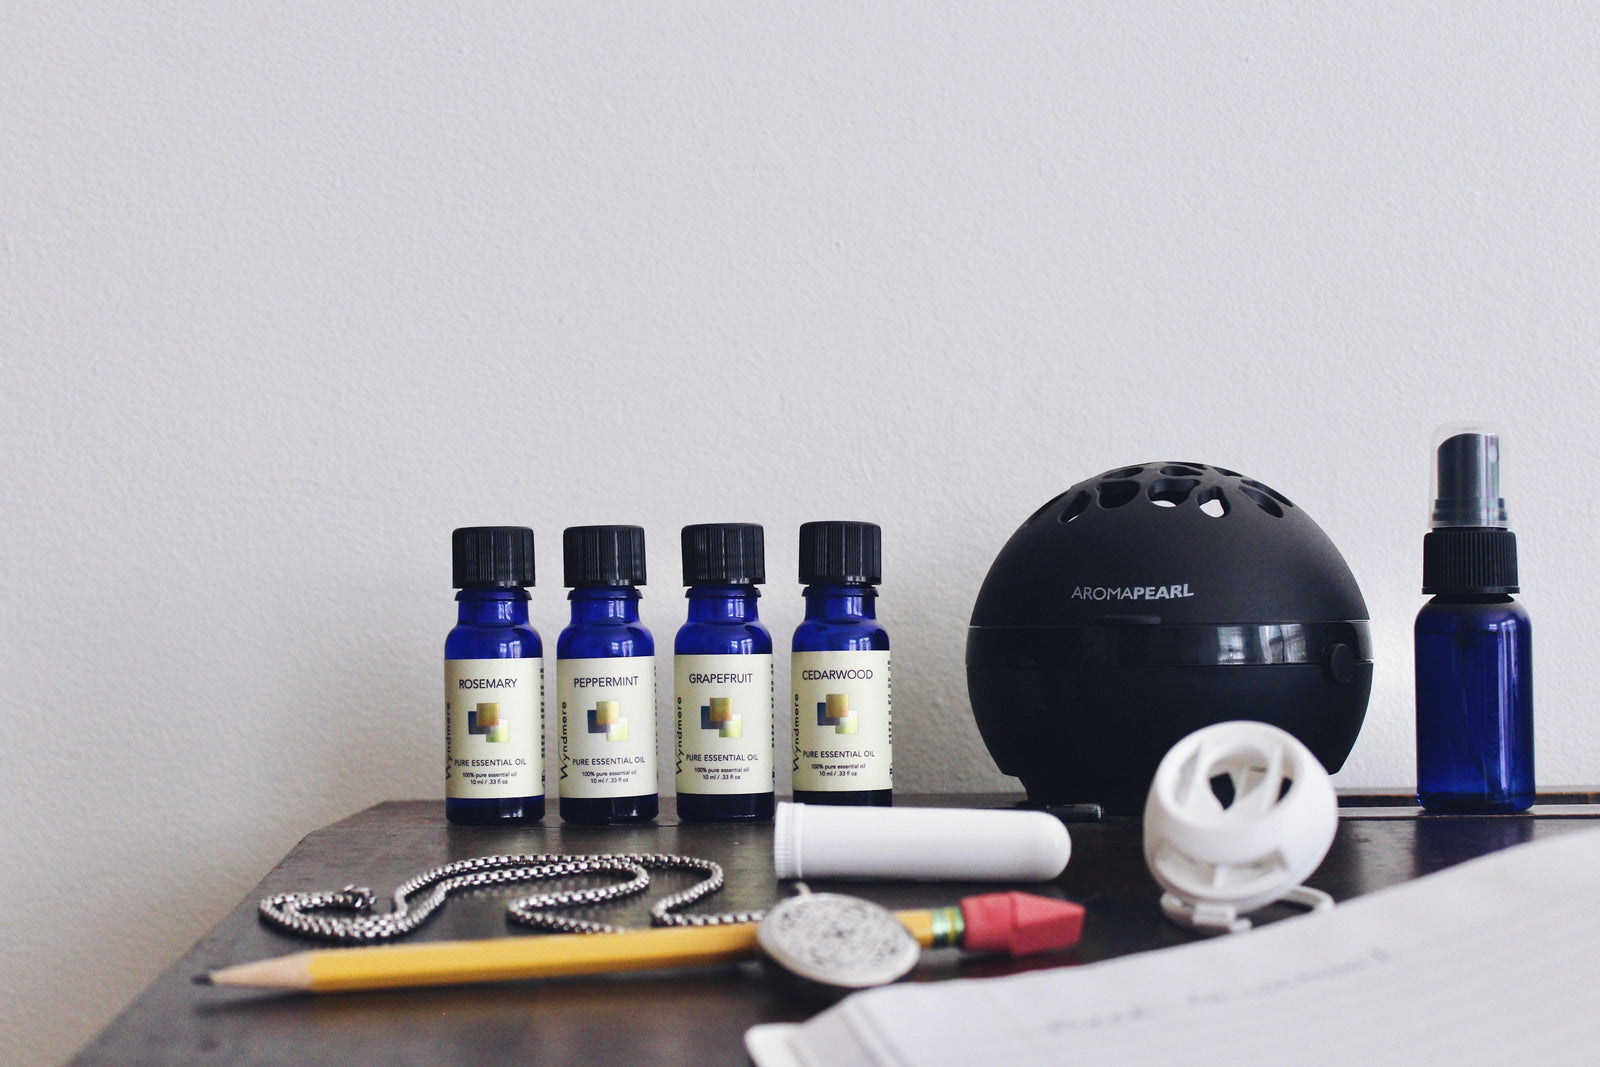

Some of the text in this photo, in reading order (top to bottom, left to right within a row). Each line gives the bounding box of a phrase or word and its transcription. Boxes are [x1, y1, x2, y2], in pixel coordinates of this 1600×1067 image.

[1071, 583, 1194, 600] AROMAPEARL
[574, 676, 638, 687] PEPPERMINT
[689, 673, 753, 684] GRAPEFRUIT
[802, 669, 873, 680] CEDARWOOD
[458, 678, 518, 689] ROSEMARY
[676, 697, 684, 774] Wyndmere
[792, 694, 801, 771] Wyndmere
[560, 701, 570, 780] Wyndmere
